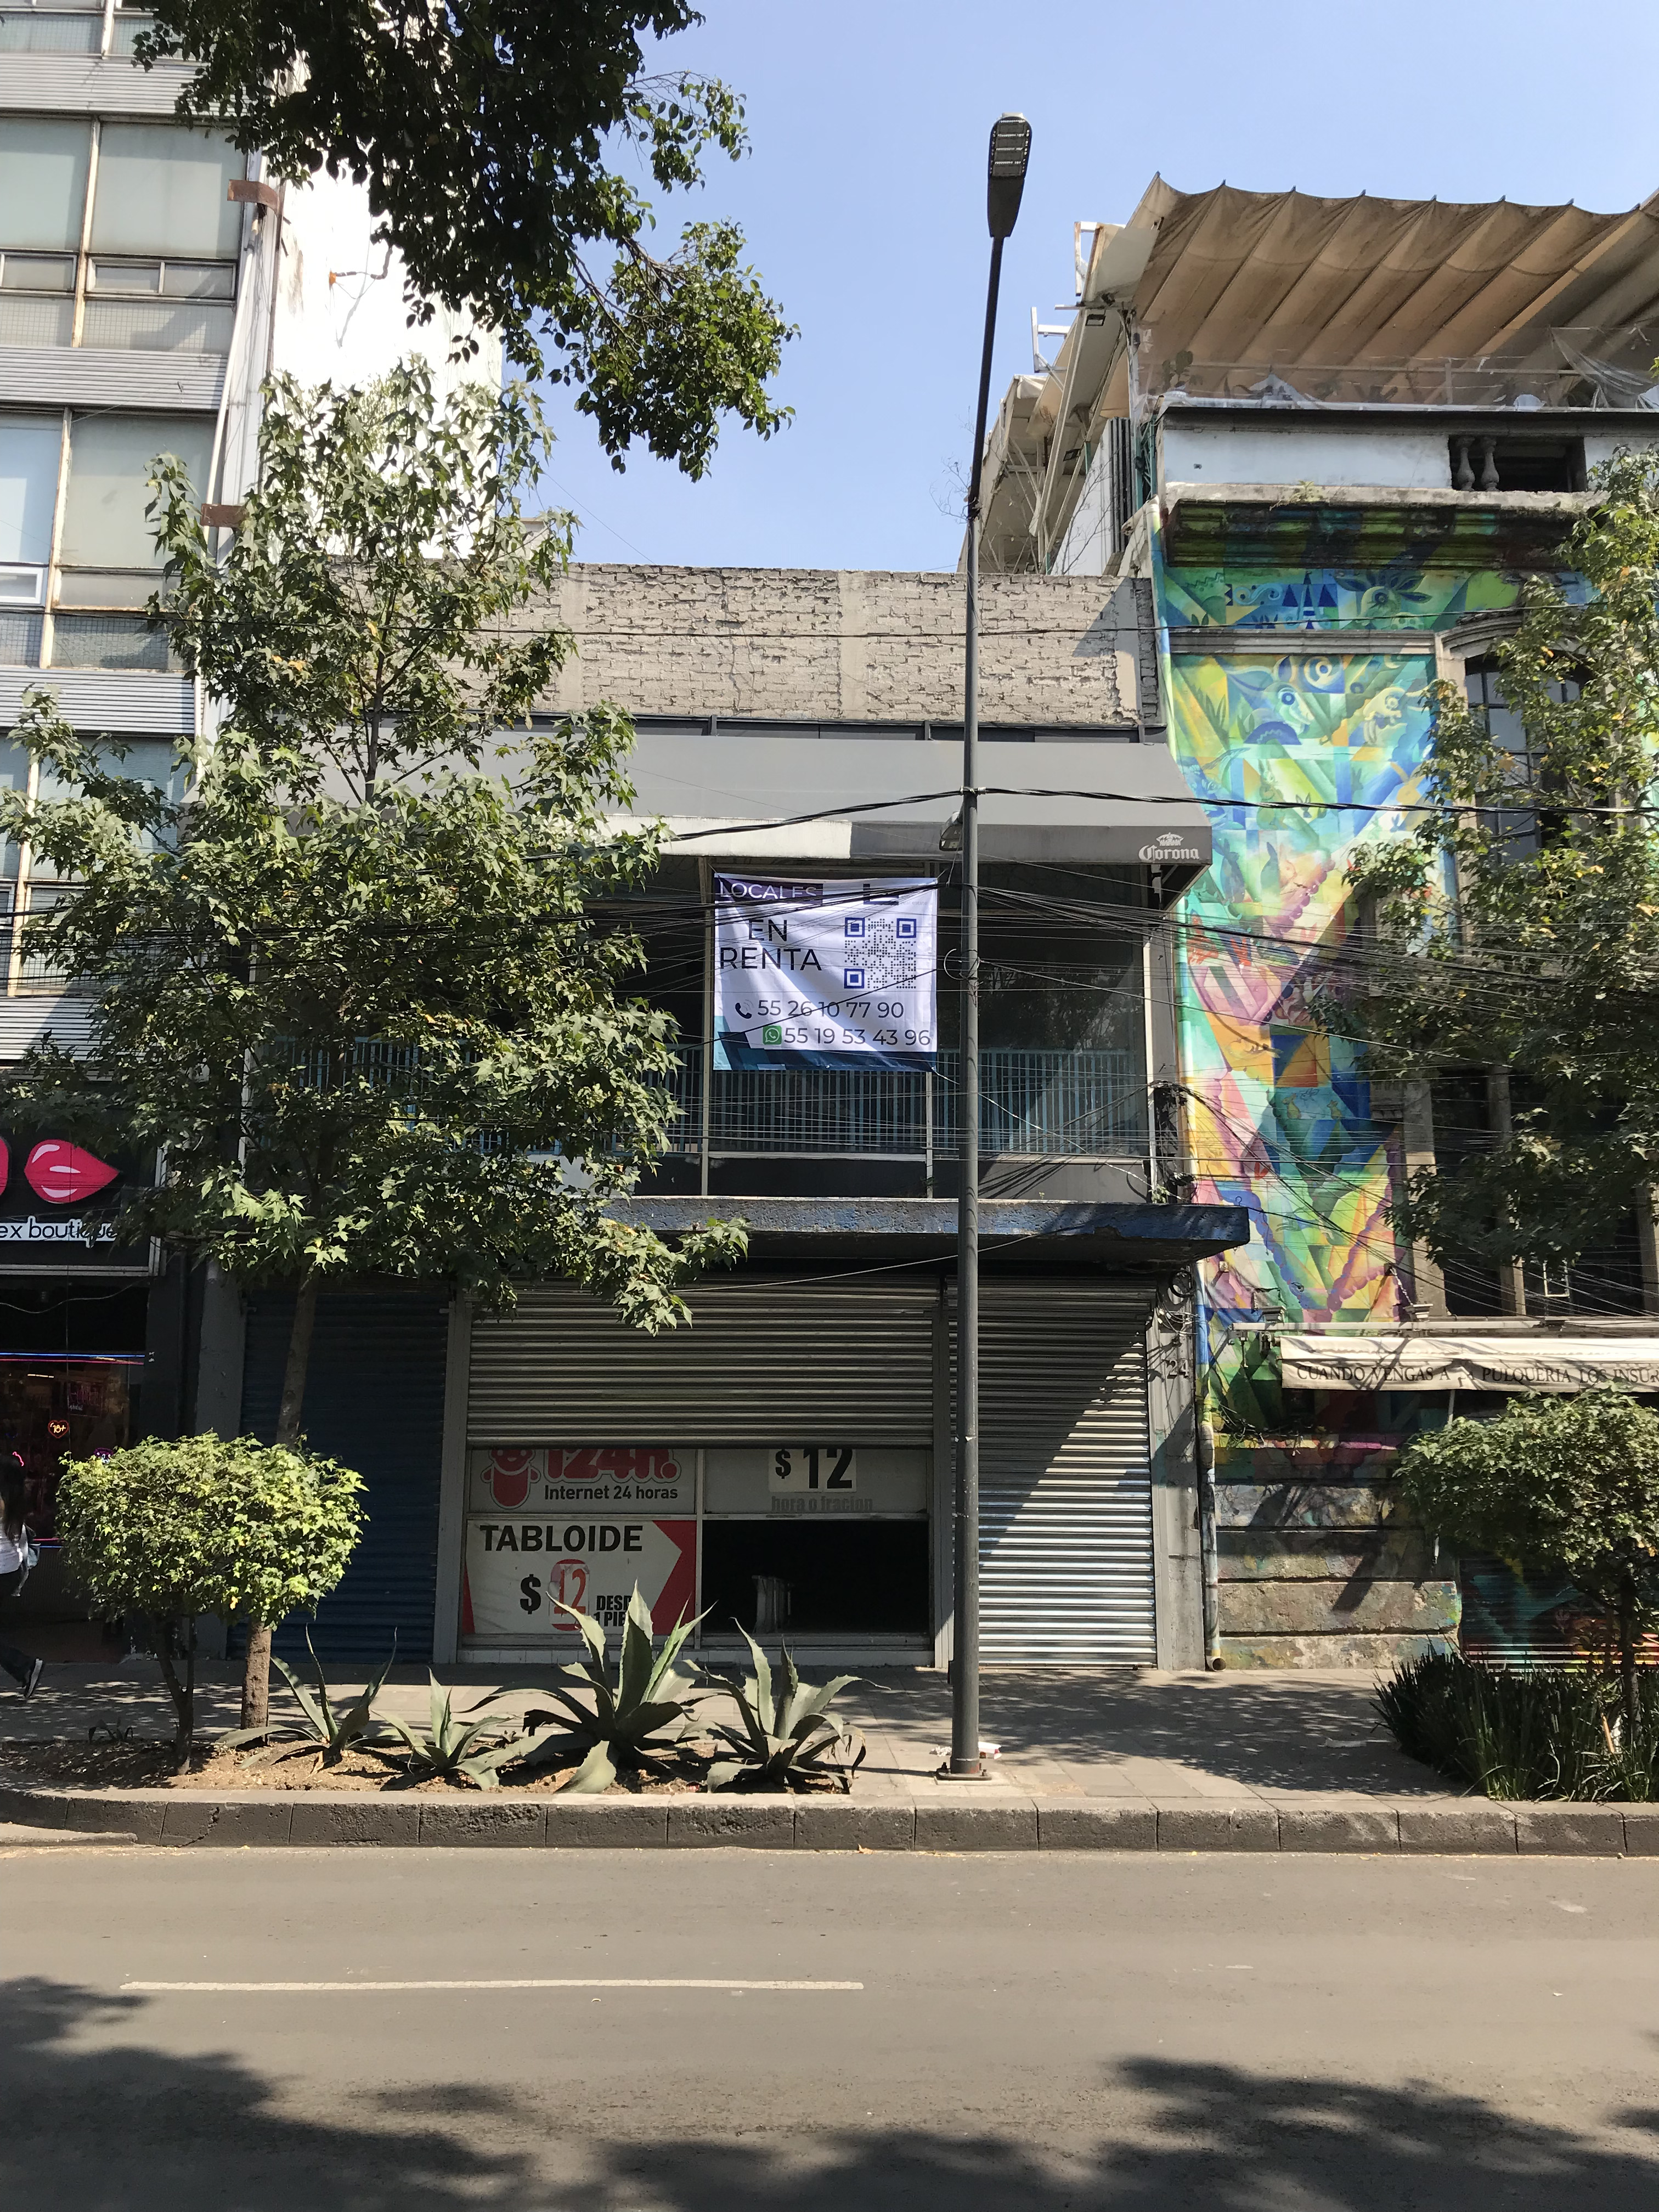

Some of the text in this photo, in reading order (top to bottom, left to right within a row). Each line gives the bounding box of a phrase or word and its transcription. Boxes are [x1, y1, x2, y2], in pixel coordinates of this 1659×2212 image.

[1138, 844, 1200, 861] Corona
[748, 919, 787, 941] EN
[720, 947, 822, 971] RENTA
[758, 1000, 904, 1018] 55 26 10 77 90
[784, 1028, 930, 1046] 55 19 53 43 96
[1169, 1359, 1189, 1376] 24
[1296, 1366, 1366, 1381] CUANDO
[1371, 1367, 1434, 1381] VENGAS
[1439, 1367, 1451, 1380] A
[1482, 1367, 1572, 1383] PULQUERIA
[1579, 1368, 1608, 1383] LOS
[52, 1425, 66, 1433] 18+
[544, 1485, 678, 1500] Internet 24 horas
[771, 1496, 805, 1511] hora
[809, 1498, 817, 1511] o
[479, 1525, 644, 1551] TABLOIDE
